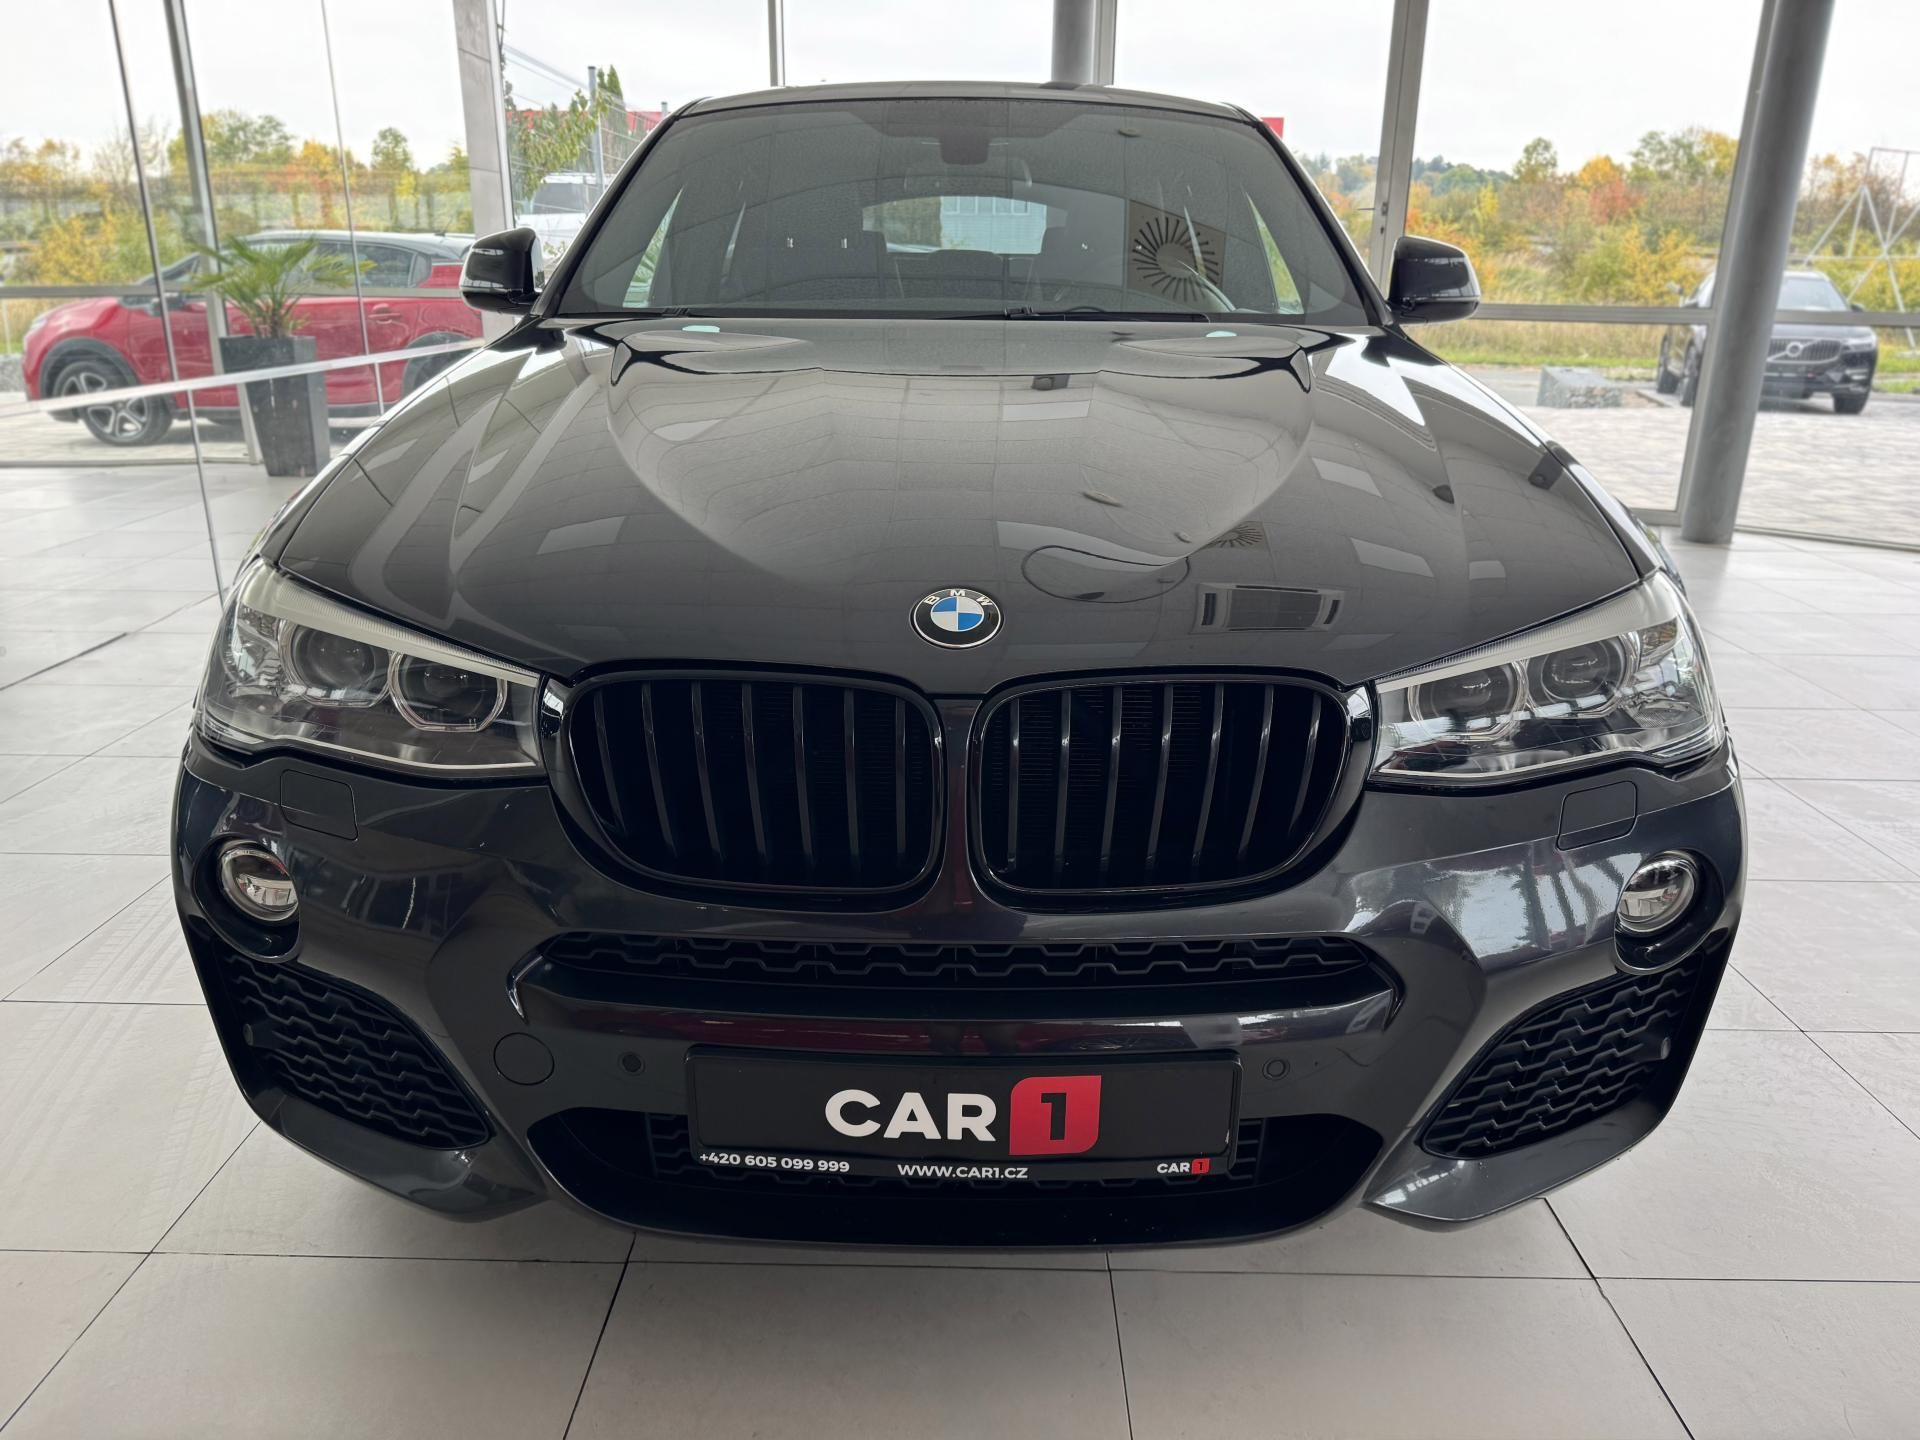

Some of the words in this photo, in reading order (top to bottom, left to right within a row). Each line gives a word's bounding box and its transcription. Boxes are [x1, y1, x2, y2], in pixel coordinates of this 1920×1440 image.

[924, 589, 993, 606] BMW
[700, 1152, 741, 1165] +420
[744, 1155, 777, 1168] 605
[781, 1157, 814, 1170] 099
[817, 1160, 850, 1173] 999
[897, 1164, 1029, 1179] WWW.CAR1.CZ
